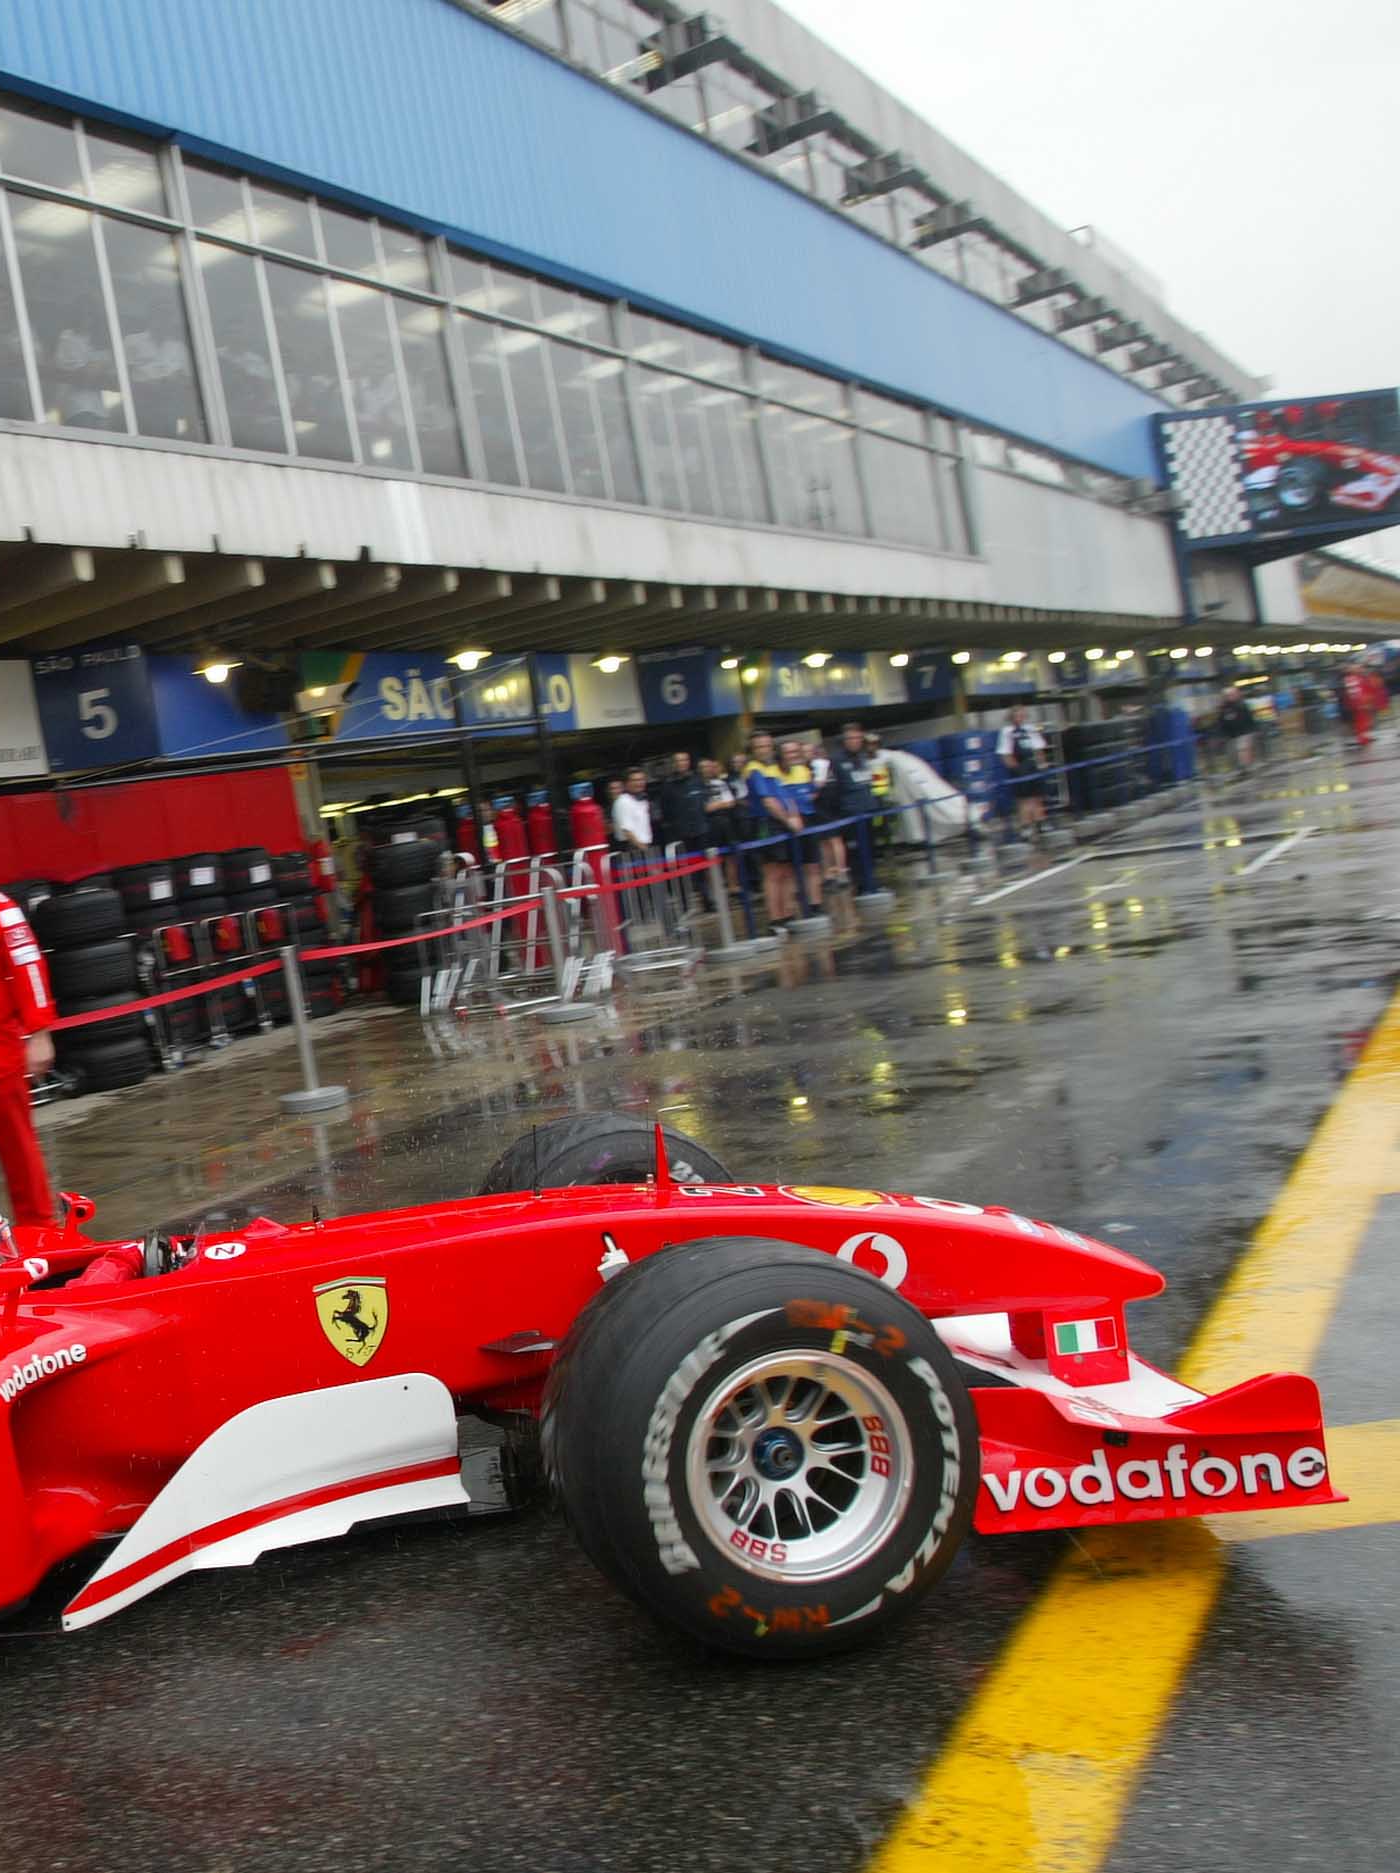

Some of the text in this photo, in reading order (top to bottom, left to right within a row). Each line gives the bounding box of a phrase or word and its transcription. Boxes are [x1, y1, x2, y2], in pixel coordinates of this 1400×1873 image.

[661, 674, 689, 705] 6
[916, 664, 937, 689] 7
[78, 688, 119, 740] 5
[861, 1415, 892, 1478] BBS
[884, 1357, 961, 1594] POTENZA
[982, 1443, 1327, 1513] vodafone
[730, 1529, 788, 1562] BBS
